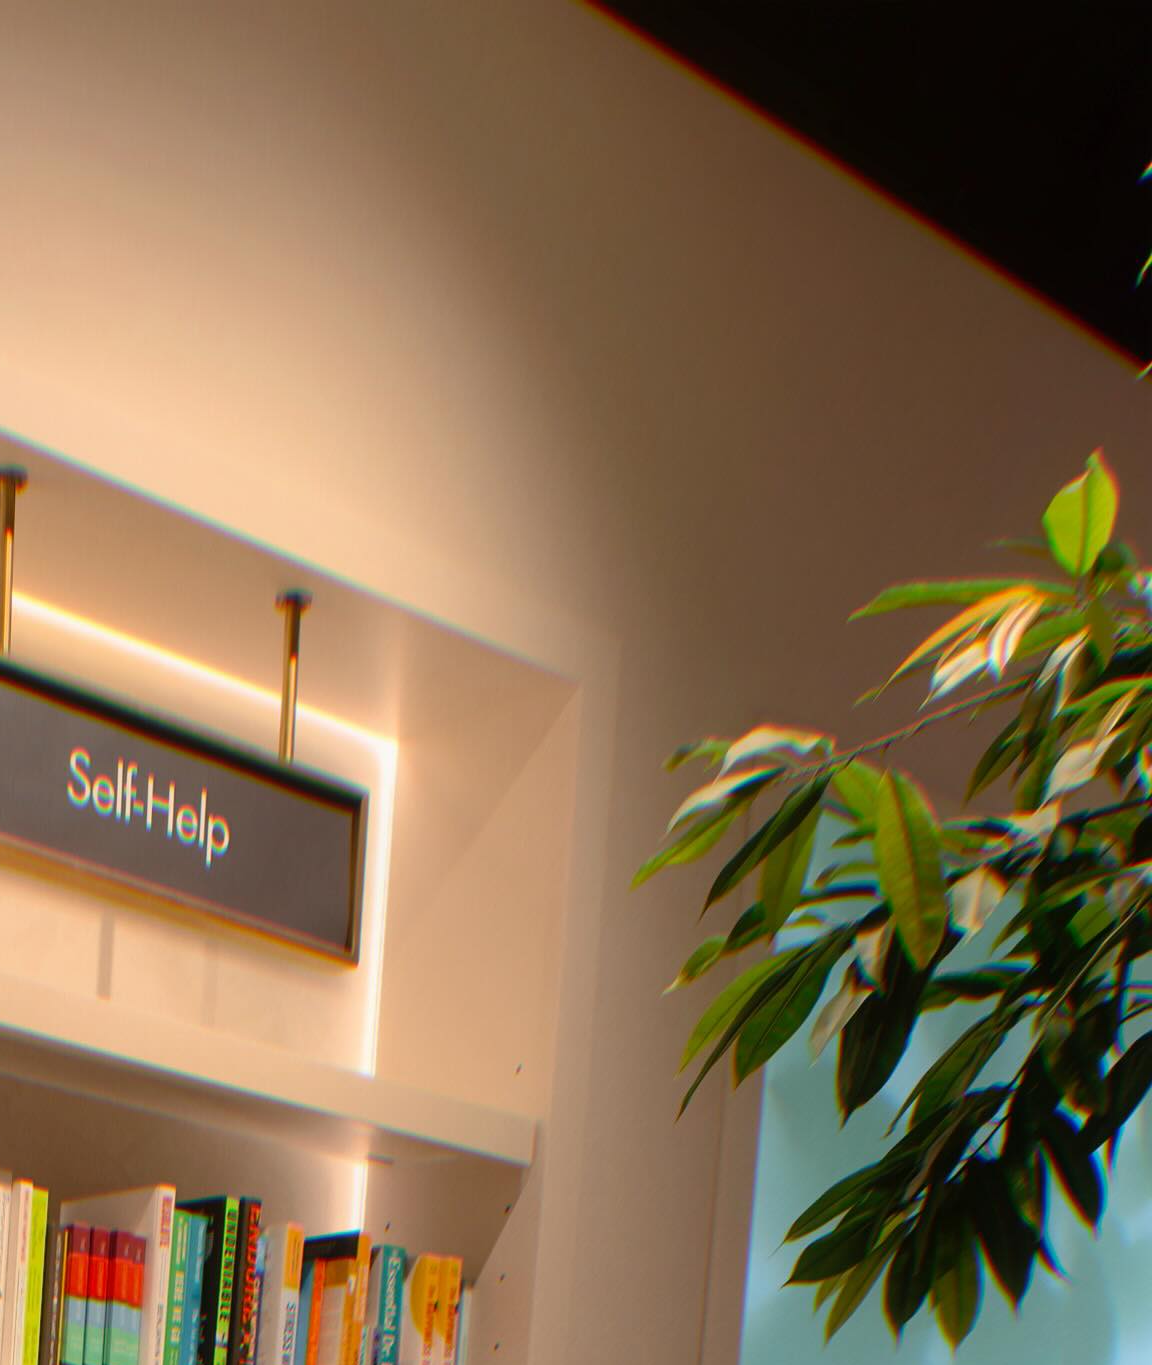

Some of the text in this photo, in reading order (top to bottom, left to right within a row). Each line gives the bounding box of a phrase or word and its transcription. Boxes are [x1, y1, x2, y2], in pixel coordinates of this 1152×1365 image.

[67, 747, 231, 869] Self-Help
[218, 1211, 236, 1325] UNDENIABLE
[241, 1205, 260, 1326] ENDURE
[383, 1257, 401, 1332] Essential
[280, 1302, 296, 1351] STRESS
[381, 1335, 394, 1356] Dr.
